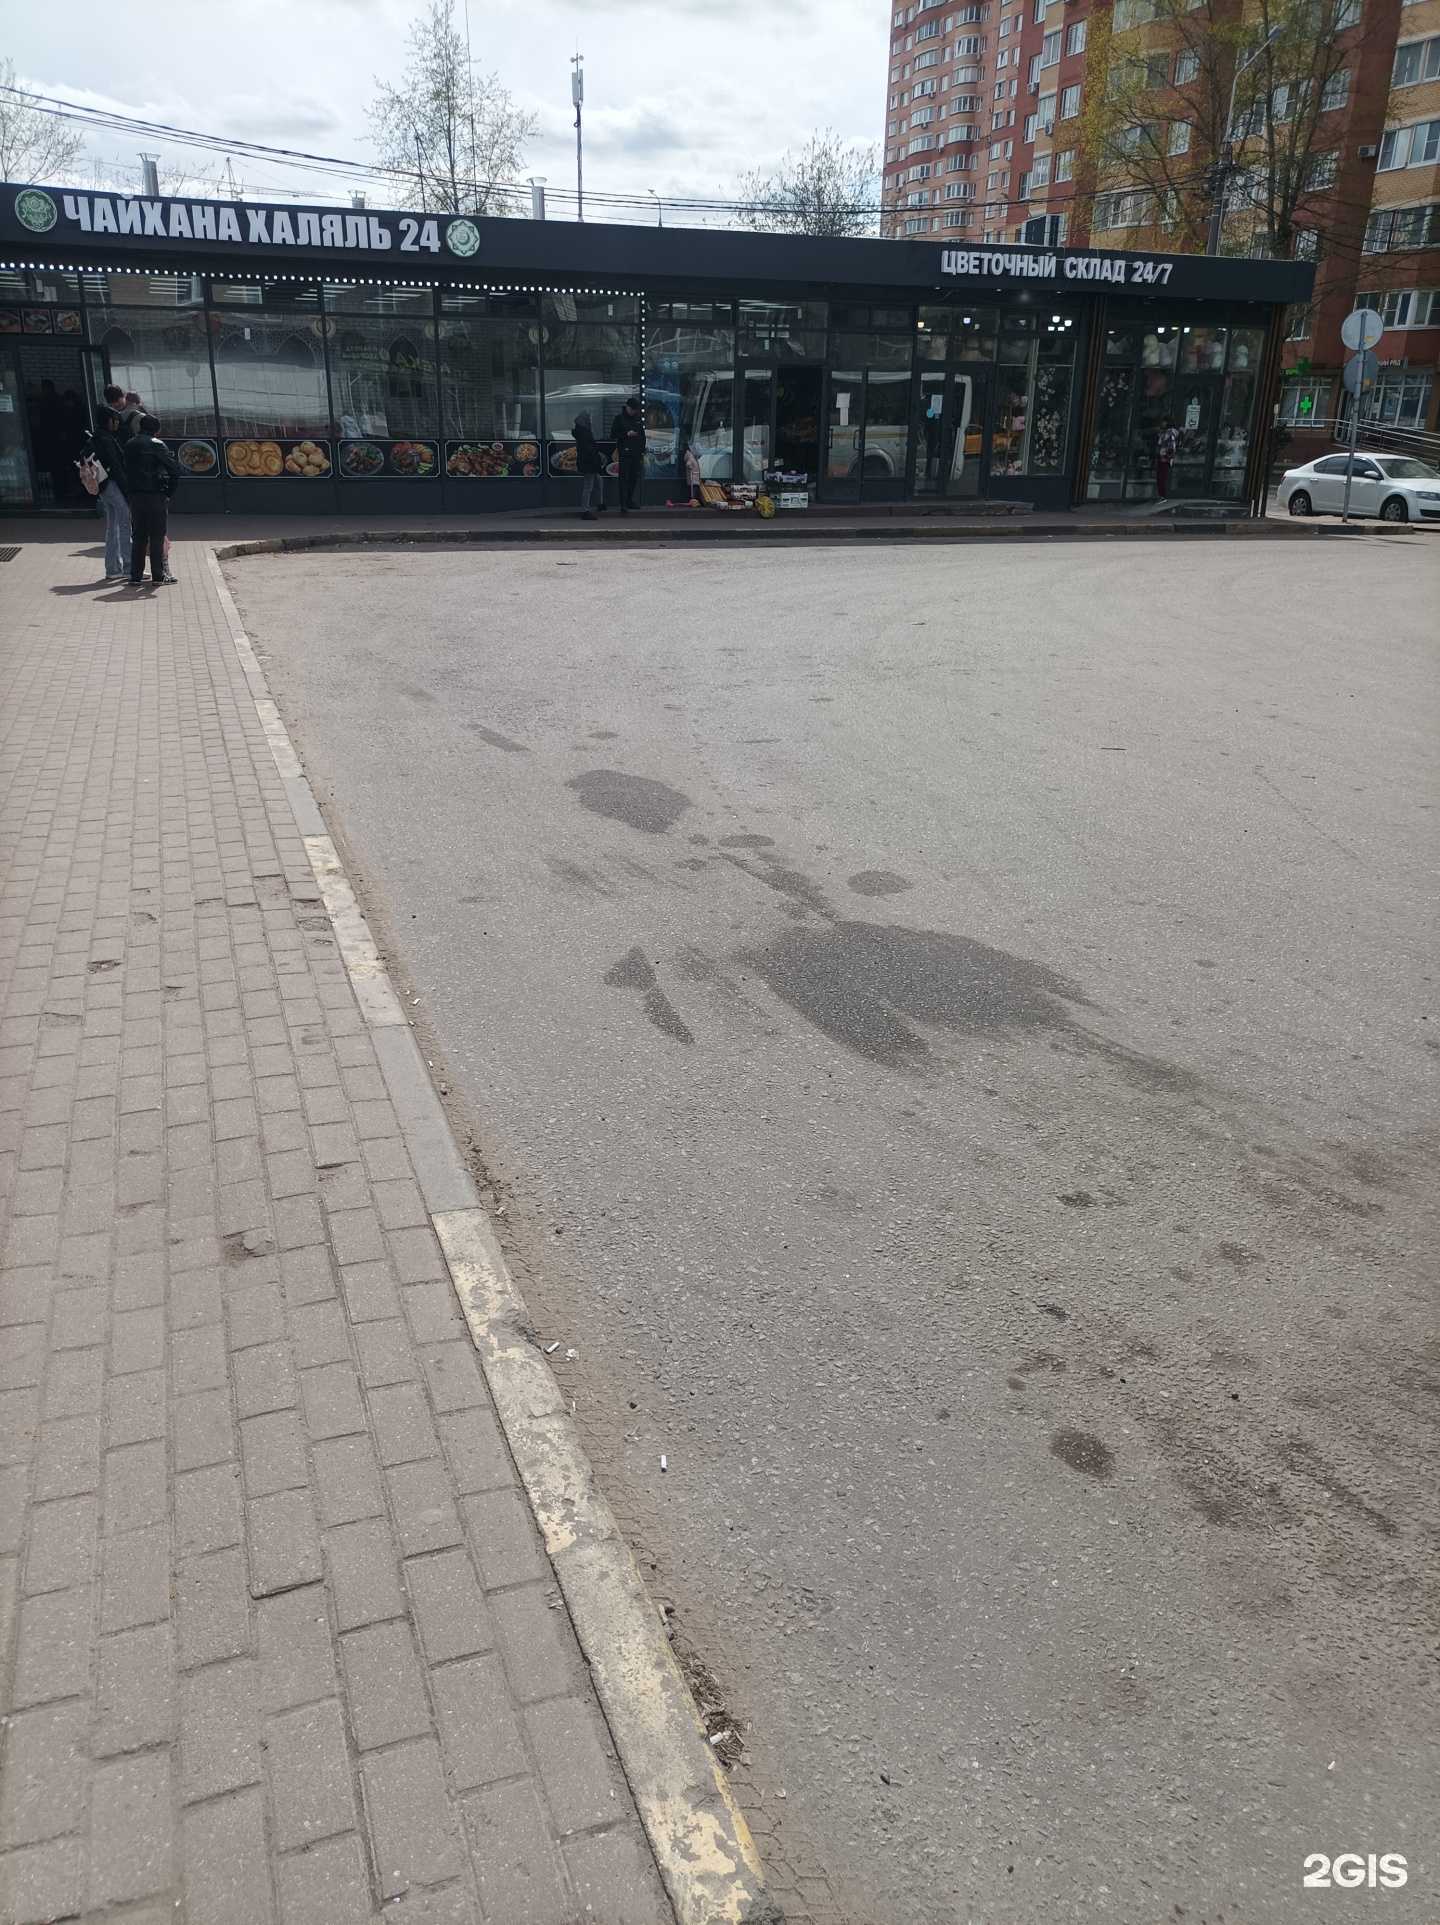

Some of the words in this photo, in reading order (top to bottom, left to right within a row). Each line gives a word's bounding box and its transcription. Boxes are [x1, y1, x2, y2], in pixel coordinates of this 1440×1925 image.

[62, 193, 242, 243] ЧАЙХАНА
[246, 209, 392, 251] ХАЛЯЛЬ
[399, 218, 441, 253] 24
[941, 250, 1057, 278] ЦВЕТОЧНЫЙ
[1064, 256, 1126, 284] СКЛАД
[1131, 261, 1174, 285] 24/7
